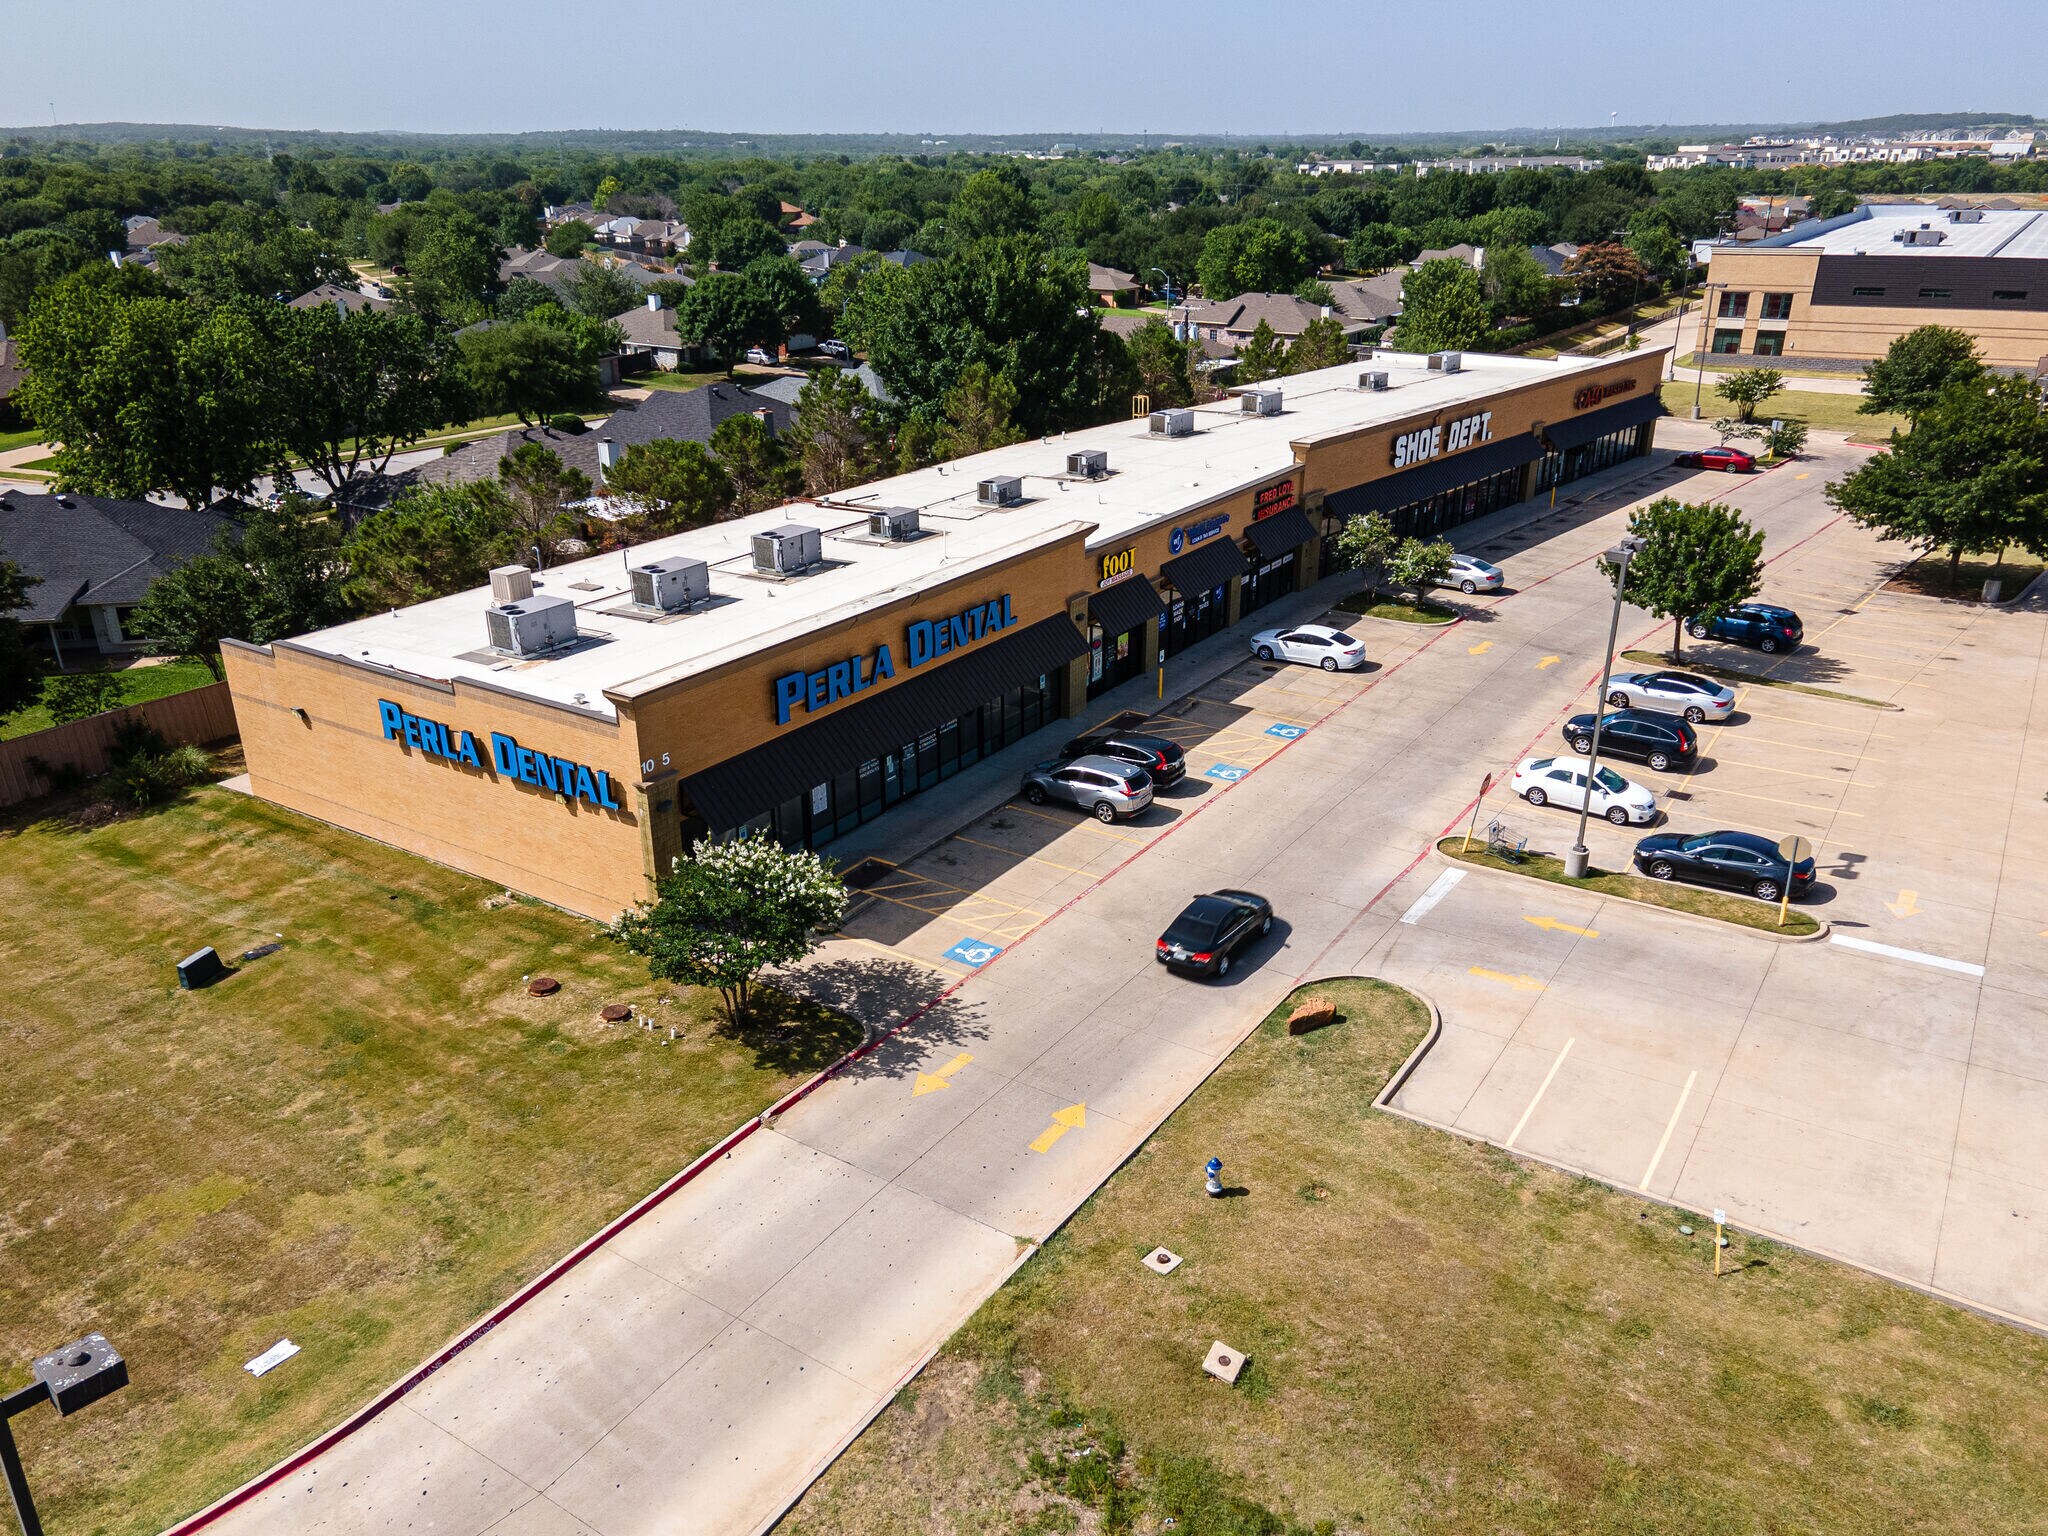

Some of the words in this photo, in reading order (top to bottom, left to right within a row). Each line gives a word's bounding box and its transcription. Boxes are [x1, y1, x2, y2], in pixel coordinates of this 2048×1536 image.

[1393, 425, 1442, 468] SHOE
[1447, 411, 1493, 452] DEPT.
[1260, 488, 1277, 504] FRED
[1279, 481, 1295, 497] LOYA
[1103, 547, 1137, 580] FOOT
[775, 644, 897, 726] PERLA
[907, 593, 1018, 668] DENTAL
[377, 698, 485, 767] PERLA
[490, 731, 620, 810] DENTAL
[420, 1359, 443, 1379] LANE
[449, 1345, 463, 1358] NO
[462, 1320, 497, 1348] PARKING
